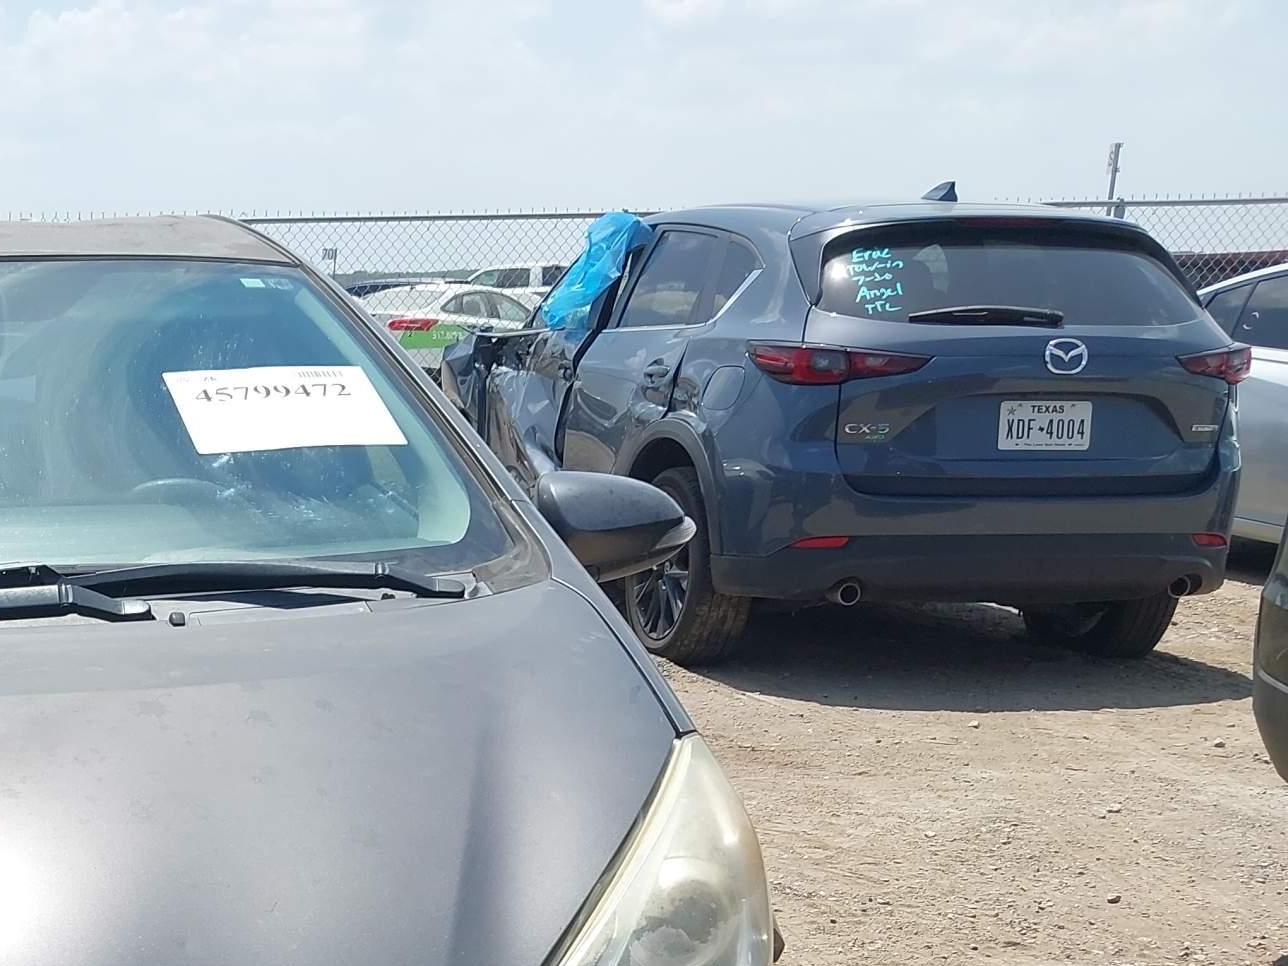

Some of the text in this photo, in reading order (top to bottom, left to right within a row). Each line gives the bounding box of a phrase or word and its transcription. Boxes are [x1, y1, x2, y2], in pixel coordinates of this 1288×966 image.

[195, 383, 352, 402] 45799472
[1031, 405, 1065, 414] TEXAS
[844, 423, 890, 434] CX-5
